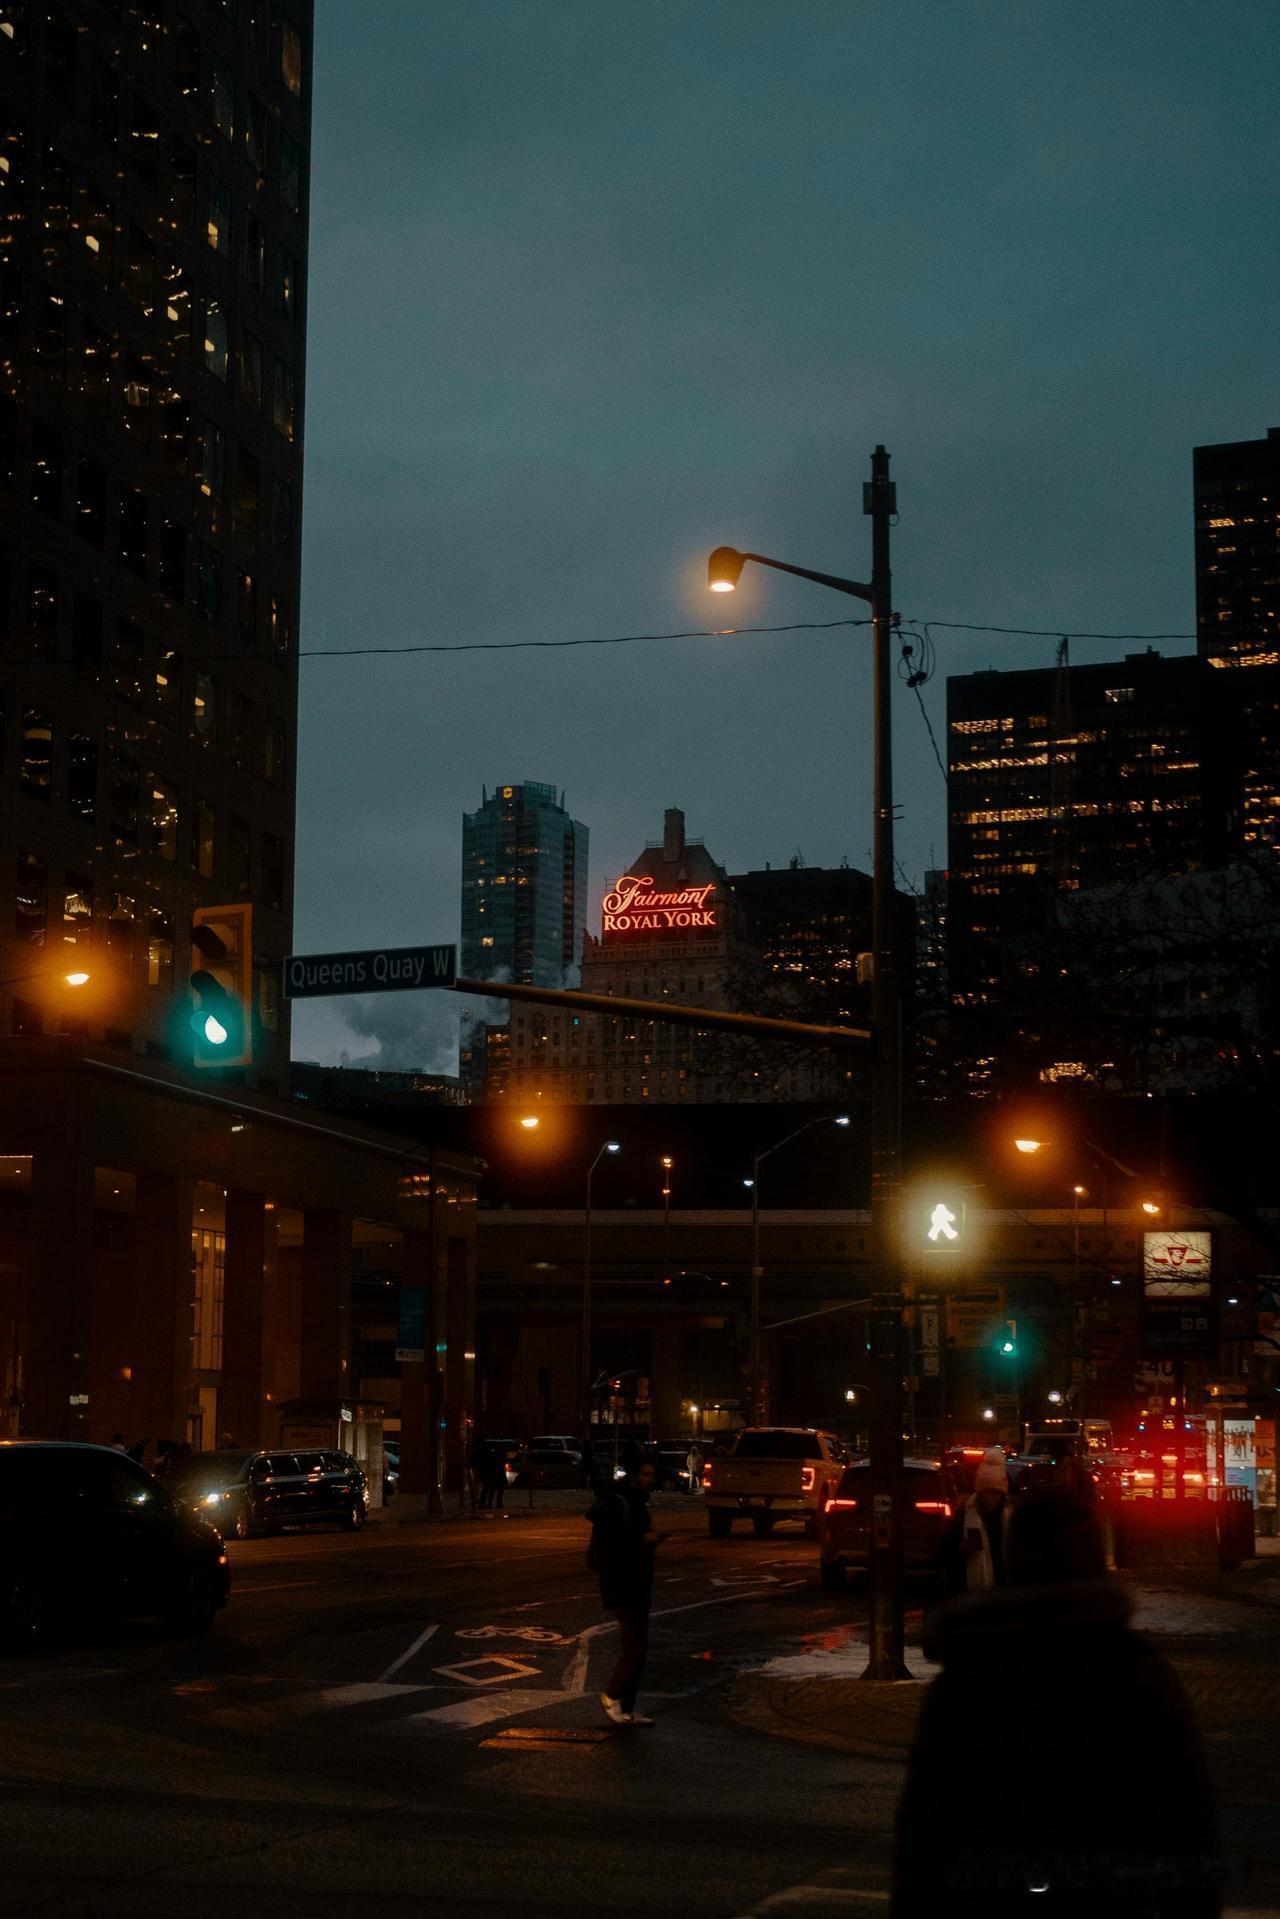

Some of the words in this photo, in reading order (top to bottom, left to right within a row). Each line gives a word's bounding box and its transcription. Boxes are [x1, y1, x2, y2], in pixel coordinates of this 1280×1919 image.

[602, 876, 717, 915] Fairmont
[603, 915, 662, 931] ROYAL
[663, 911, 717, 927] YORK
[290, 960, 366, 988] Queens
[372, 953, 425, 985] Quay
[432, 949, 450, 976] W
